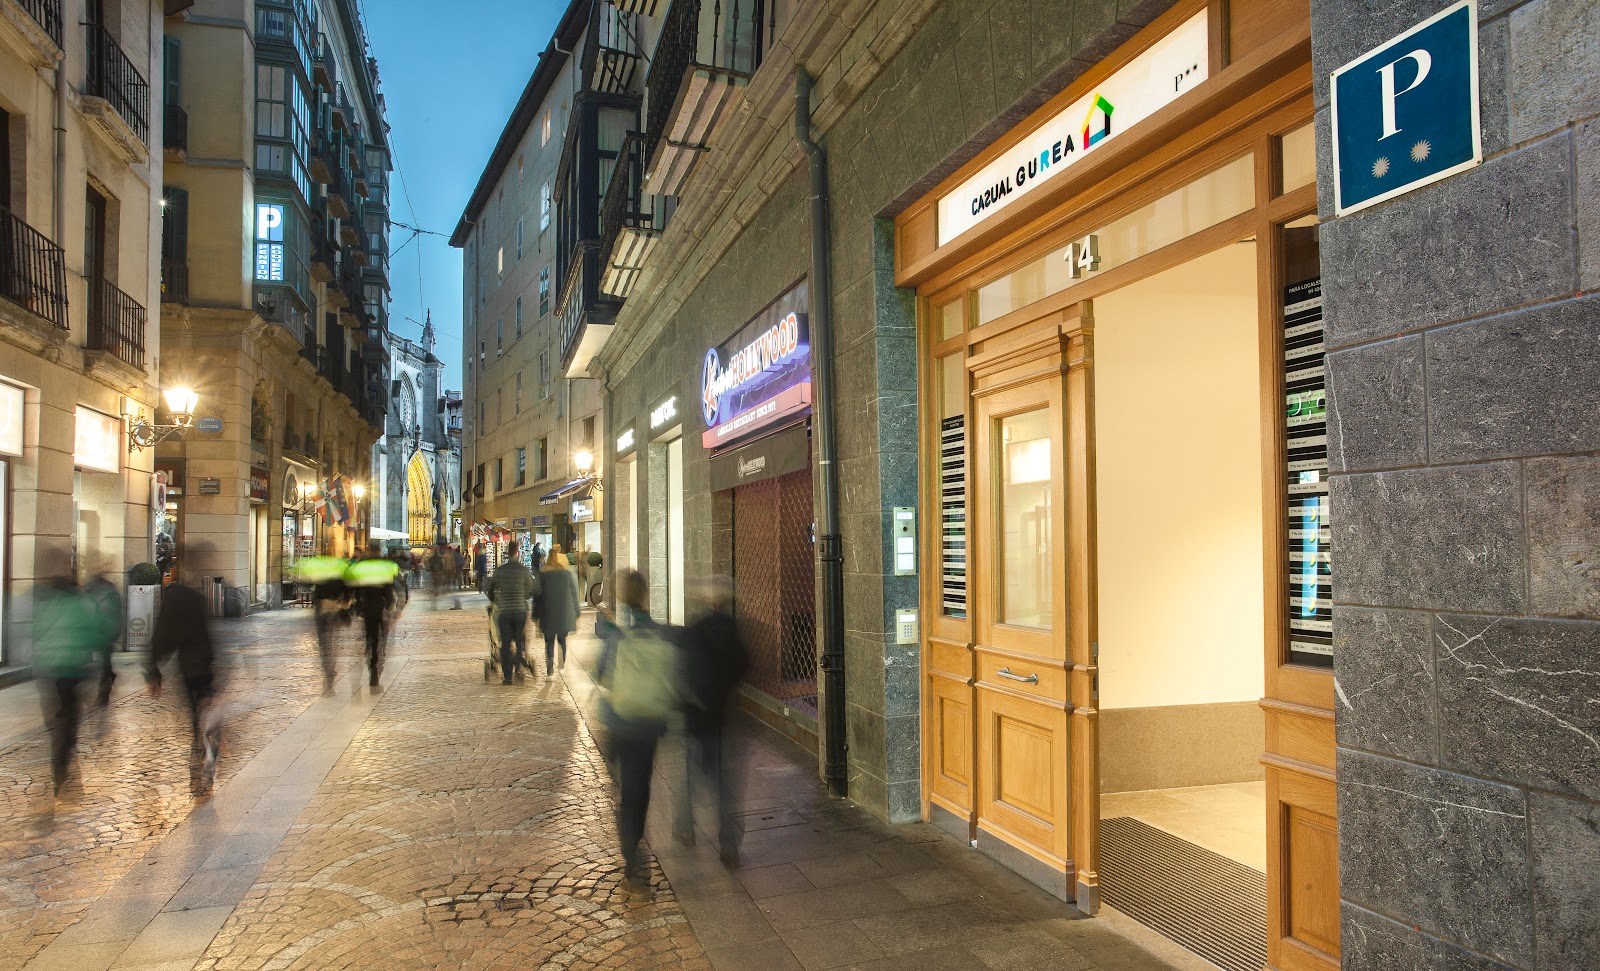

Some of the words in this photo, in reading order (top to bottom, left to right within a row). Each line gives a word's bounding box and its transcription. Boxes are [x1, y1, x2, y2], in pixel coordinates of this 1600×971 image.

[1376, 49, 1432, 142] P
[971, 176, 1013, 216] CASUAL
[1016, 134, 1075, 187] GUREA
[258, 206, 282, 239] P
[1063, 234, 1101, 279] 14
[1288, 286, 1300, 294] PARA
[731, 312, 798, 389] HOLLYWOOD
